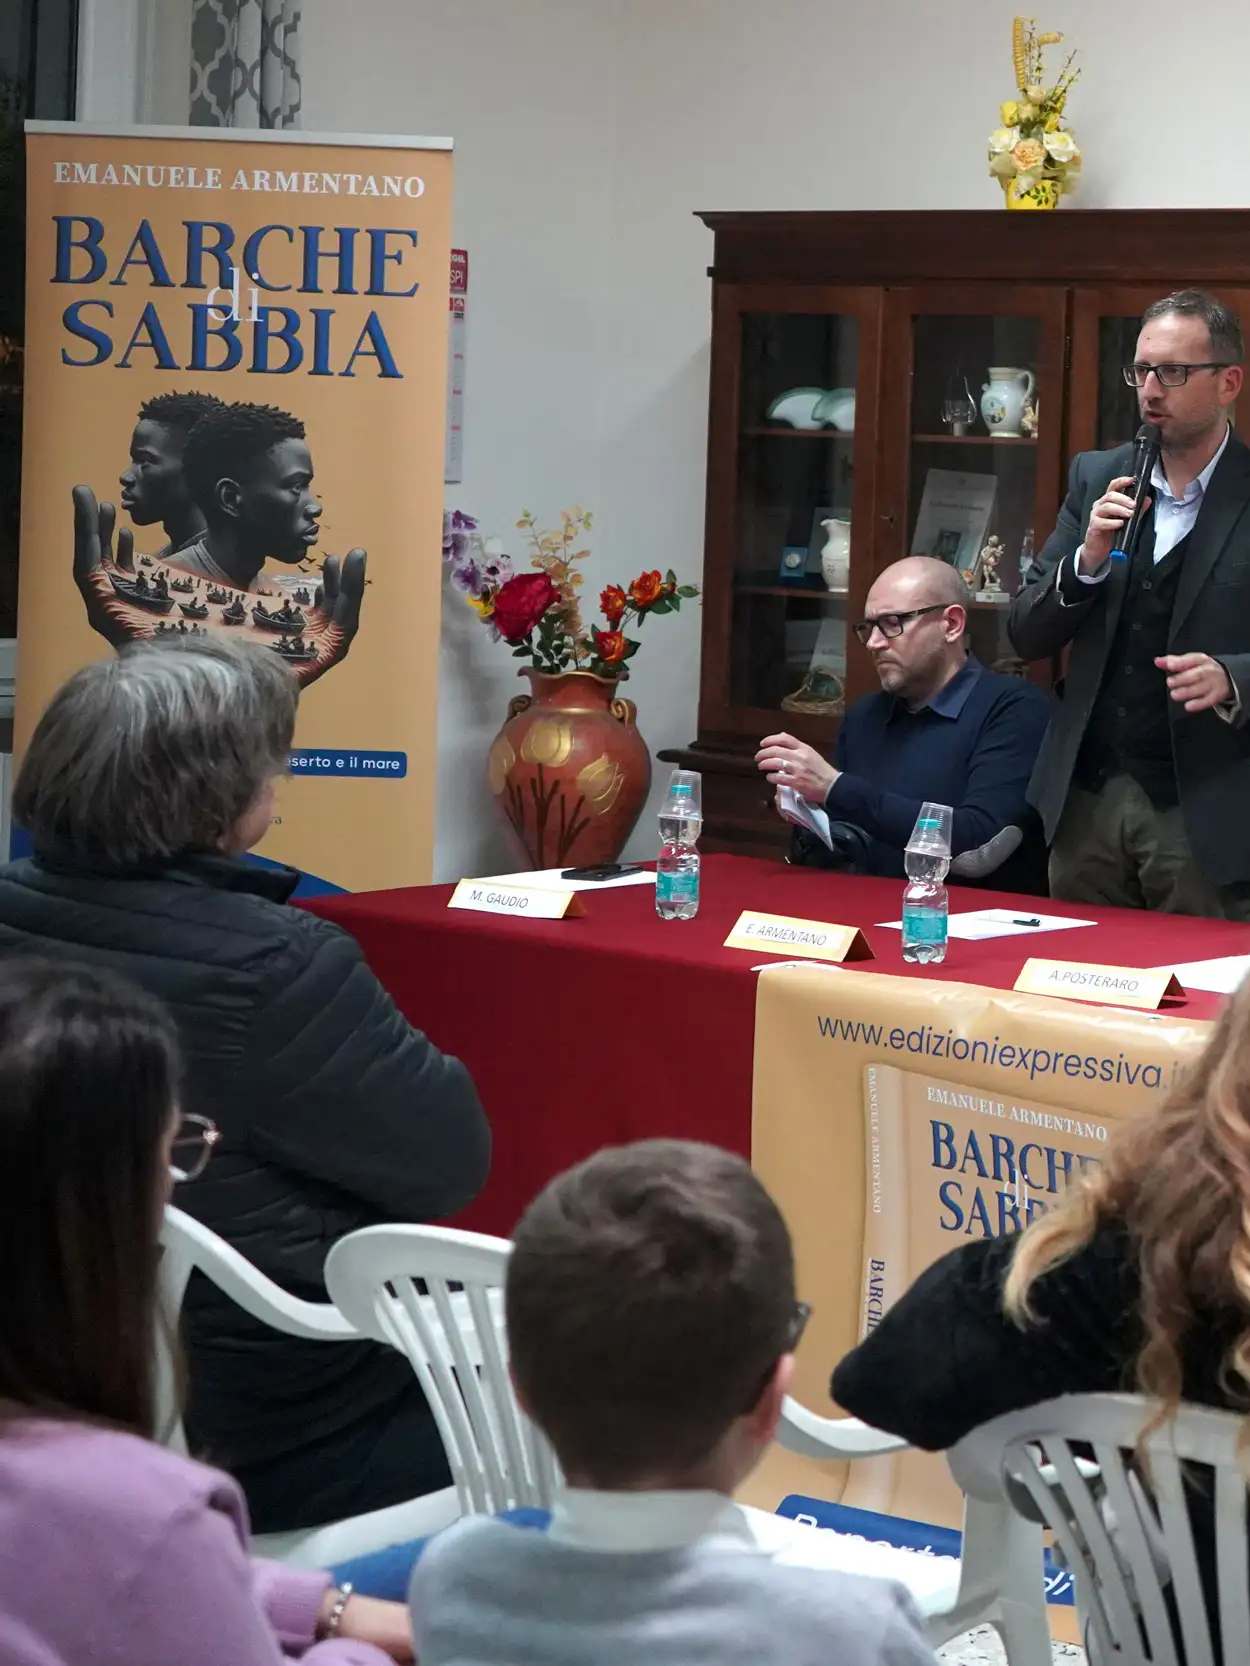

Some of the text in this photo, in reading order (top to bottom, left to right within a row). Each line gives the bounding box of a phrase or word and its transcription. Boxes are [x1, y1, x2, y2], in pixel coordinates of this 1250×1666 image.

[54, 162, 426, 198] EMANUELE ARMENTANO
[50, 215, 420, 298] BARCHE
[206, 266, 264, 323] di
[61, 299, 405, 379] SABBIA
[335, 757, 345, 768] e
[350, 756, 358, 769] il
[362, 759, 400, 770] mare
[469, 890, 529, 909] M. GAUDIO
[745, 923, 827, 946] E. ARMENTANO
[927, 1086, 1107, 1142] EMANUELE ARMENTANO
[871, 1135, 882, 1214] ARMENTANO
[1003, 1167, 1031, 1210] di
